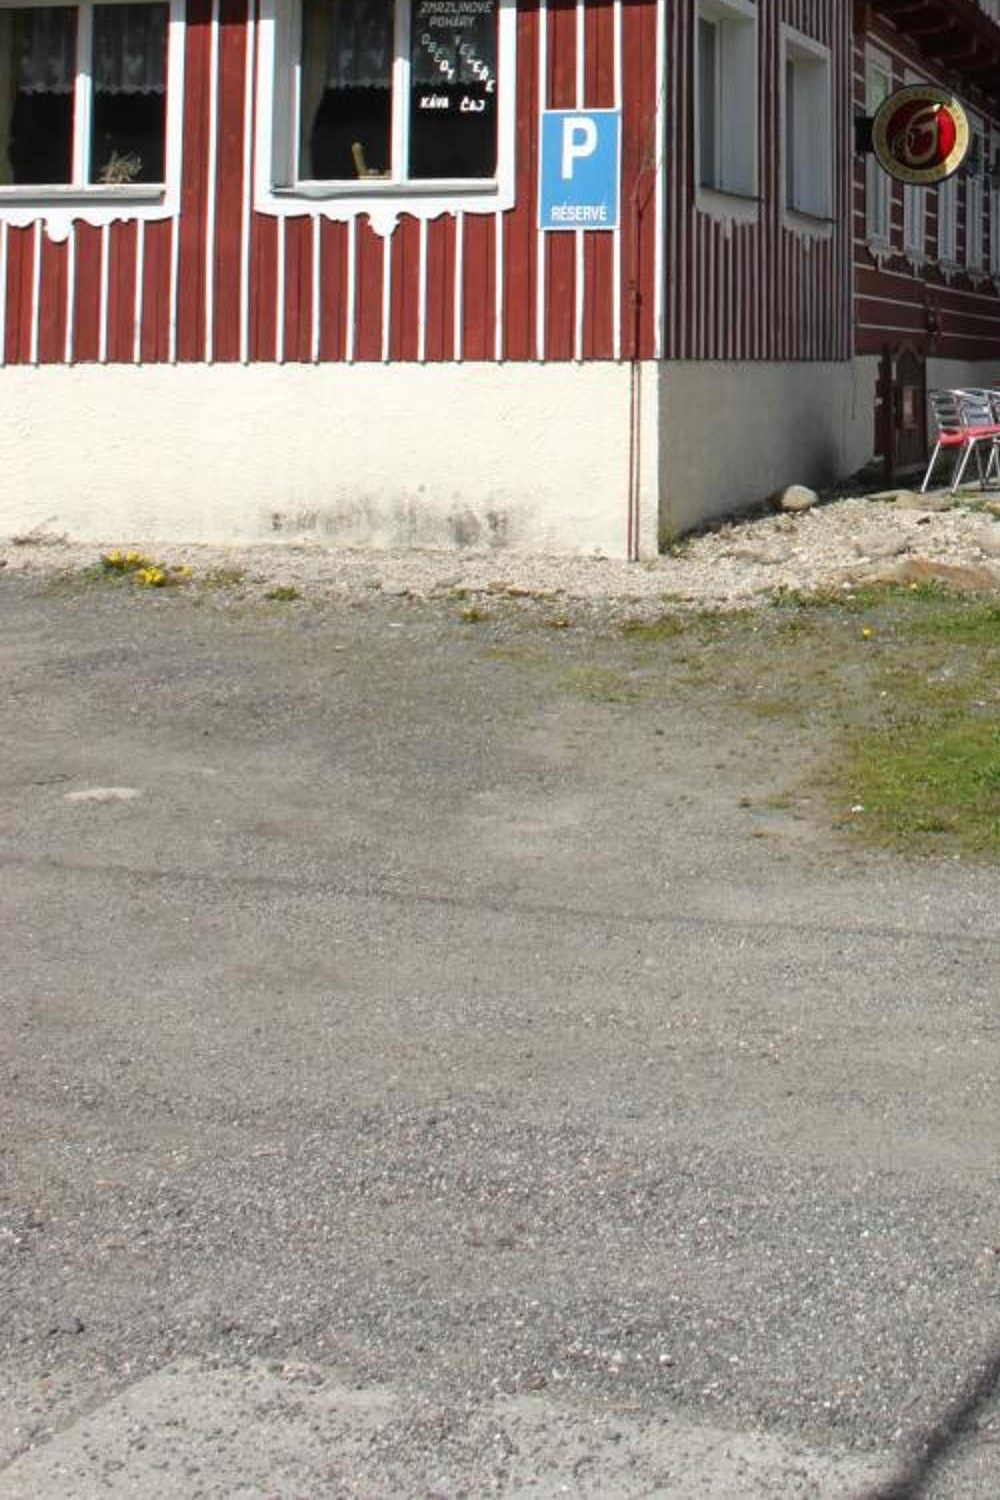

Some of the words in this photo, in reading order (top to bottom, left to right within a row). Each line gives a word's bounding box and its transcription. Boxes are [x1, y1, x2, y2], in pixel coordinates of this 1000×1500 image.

[421, 94, 449, 109] KÁVA
[461, 96, 485, 112] ČAJ
[562, 117, 598, 180] P
